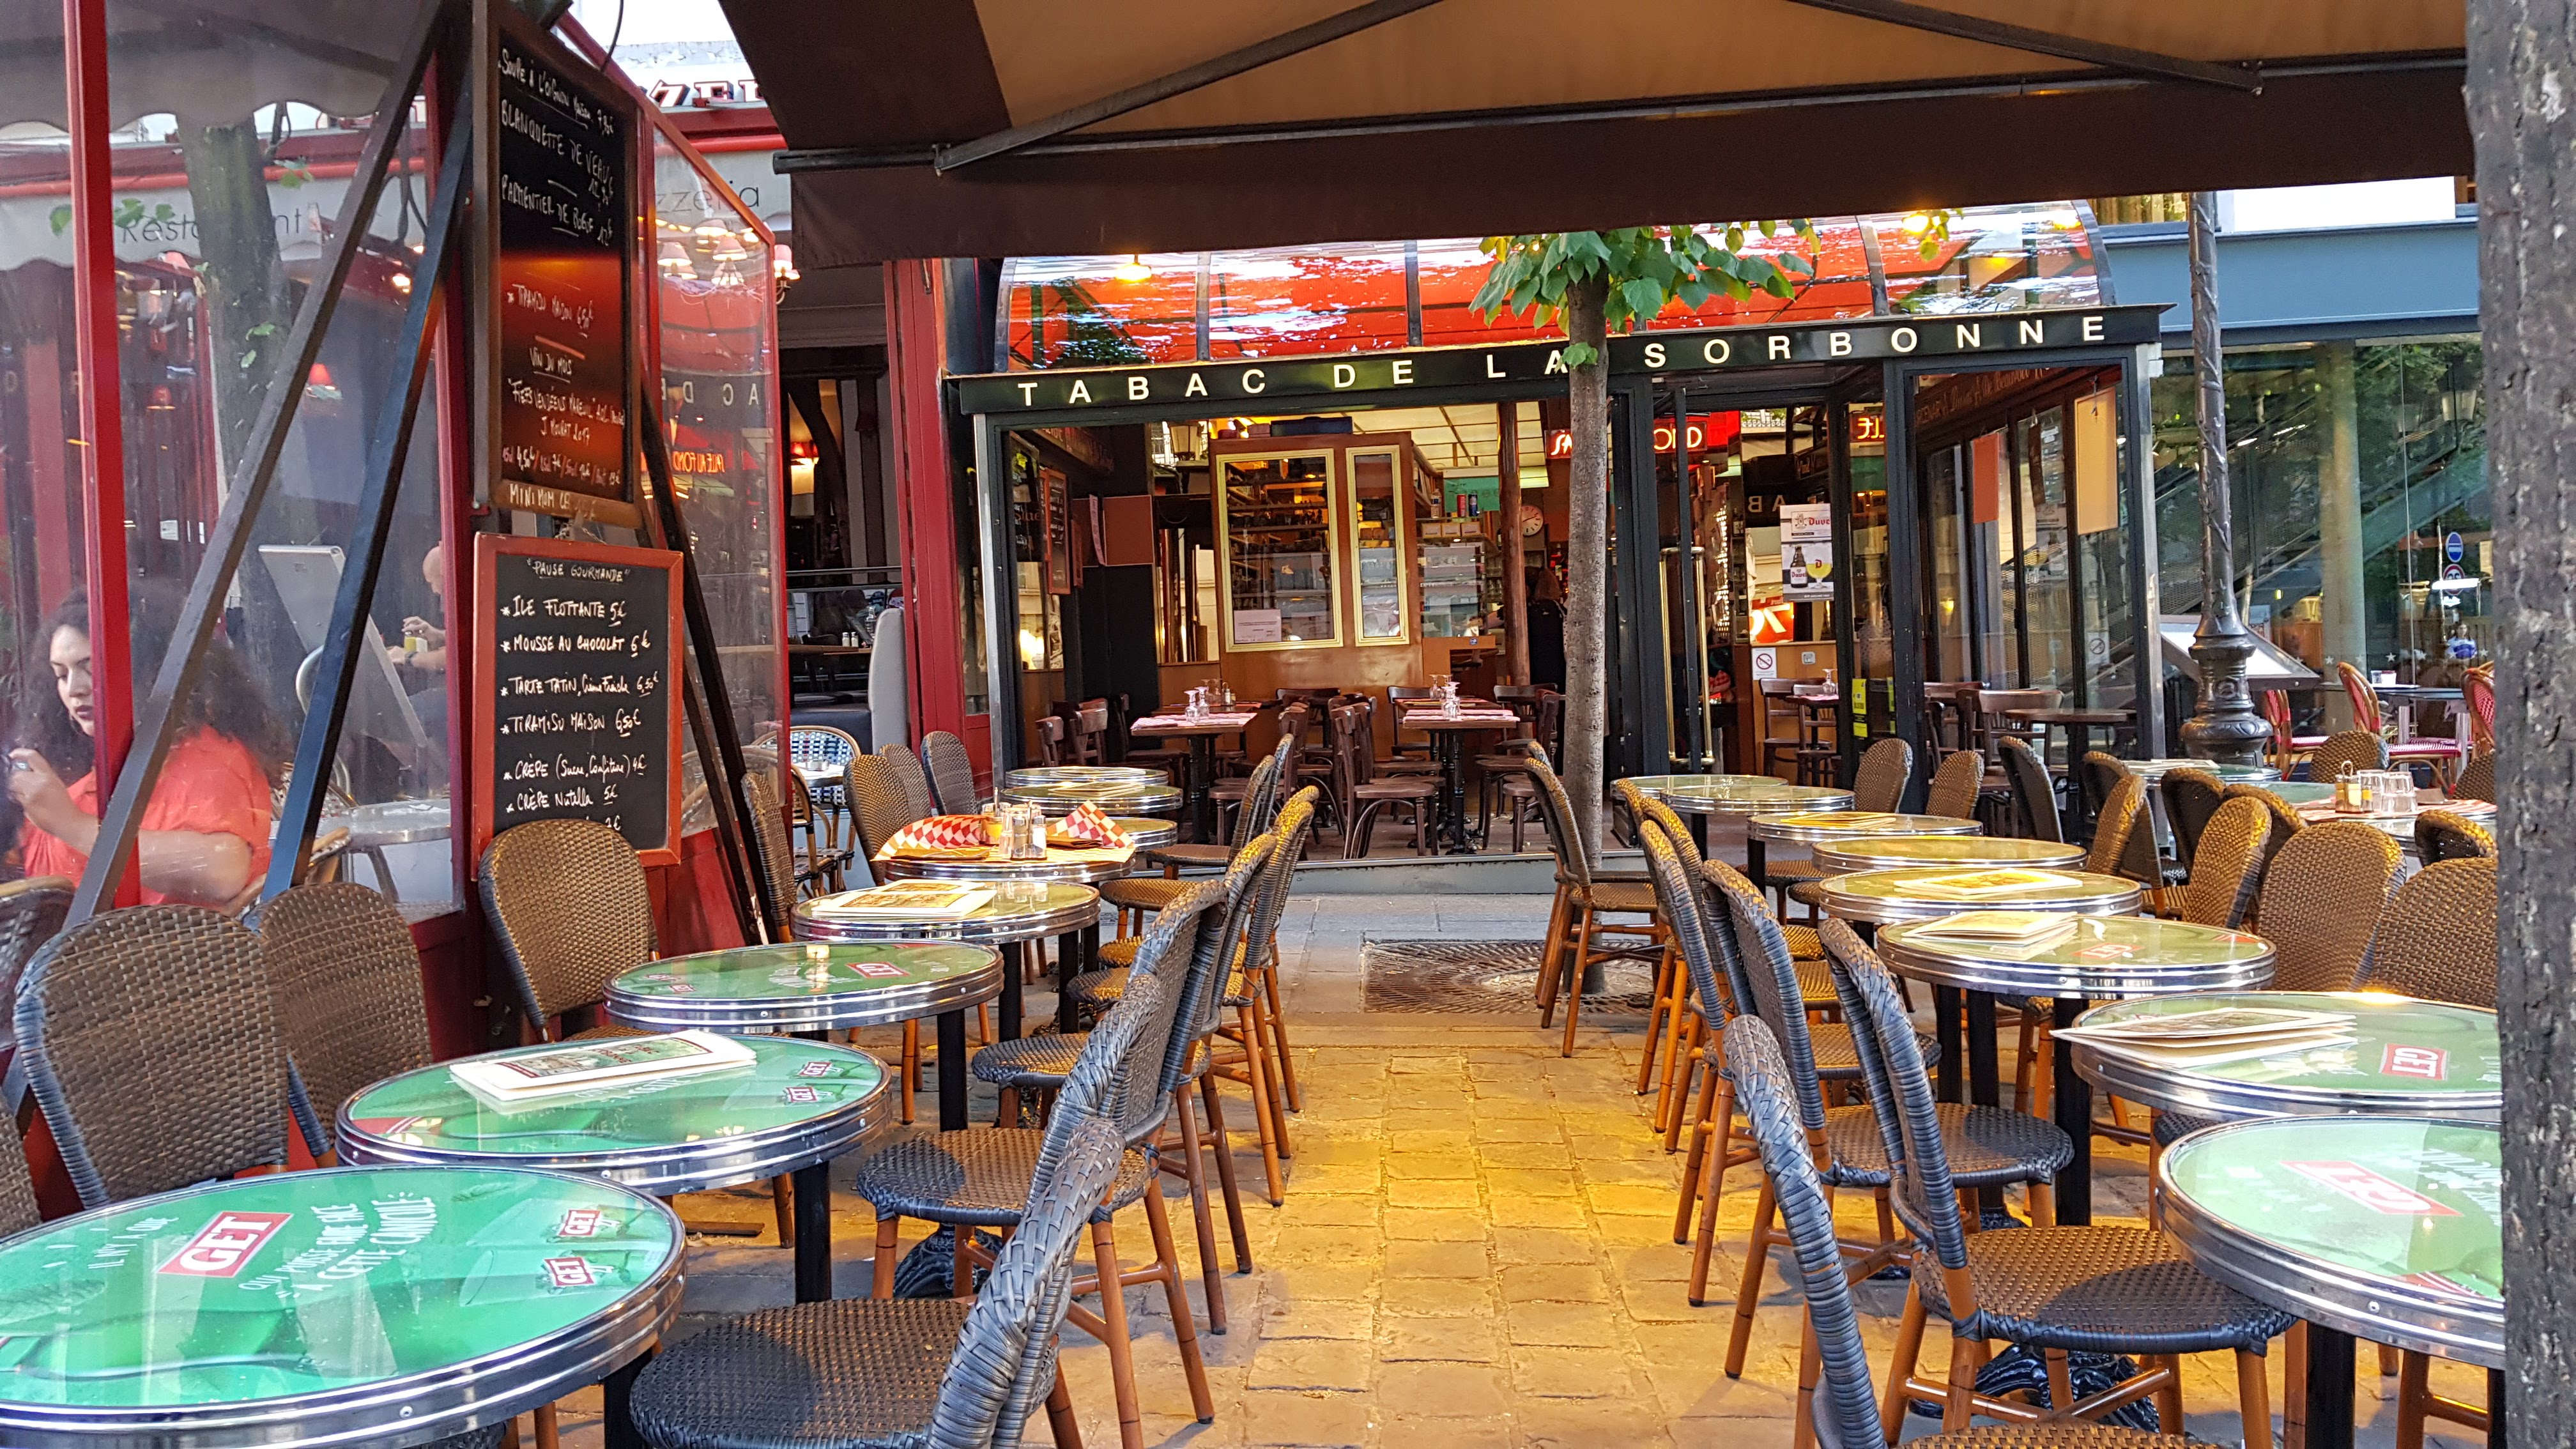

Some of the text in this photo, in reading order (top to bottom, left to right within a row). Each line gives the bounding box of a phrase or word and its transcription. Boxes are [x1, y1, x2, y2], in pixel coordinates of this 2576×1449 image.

[1018, 315, 2104, 406] TABAC DE LA SORBONNE
[1808, 517, 1830, 526] Duve
[512, 595, 535, 618] ILE
[543, 598, 606, 618] FLOTTANTE
[513, 634, 555, 652] MOUSSE
[558, 635, 572, 652] AU
[576, 634, 625, 652] CHOCOLAT
[508, 675, 544, 695] TARTE
[555, 786, 594, 807] Nutella
[803, 1062, 827, 1075] GET
[2391, 1047, 2439, 1078] GET
[790, 1089, 813, 1101] GET
[2301, 1163, 2432, 1211] GET
[564, 1211, 597, 1235] GET
[180, 1216, 272, 1271] GET
[317, 1249, 408, 1280] CETTE
[369, 1196, 439, 1245] CANICULE
[274, 1248, 348, 1273] PUISSE
[550, 1259, 589, 1284] GET
